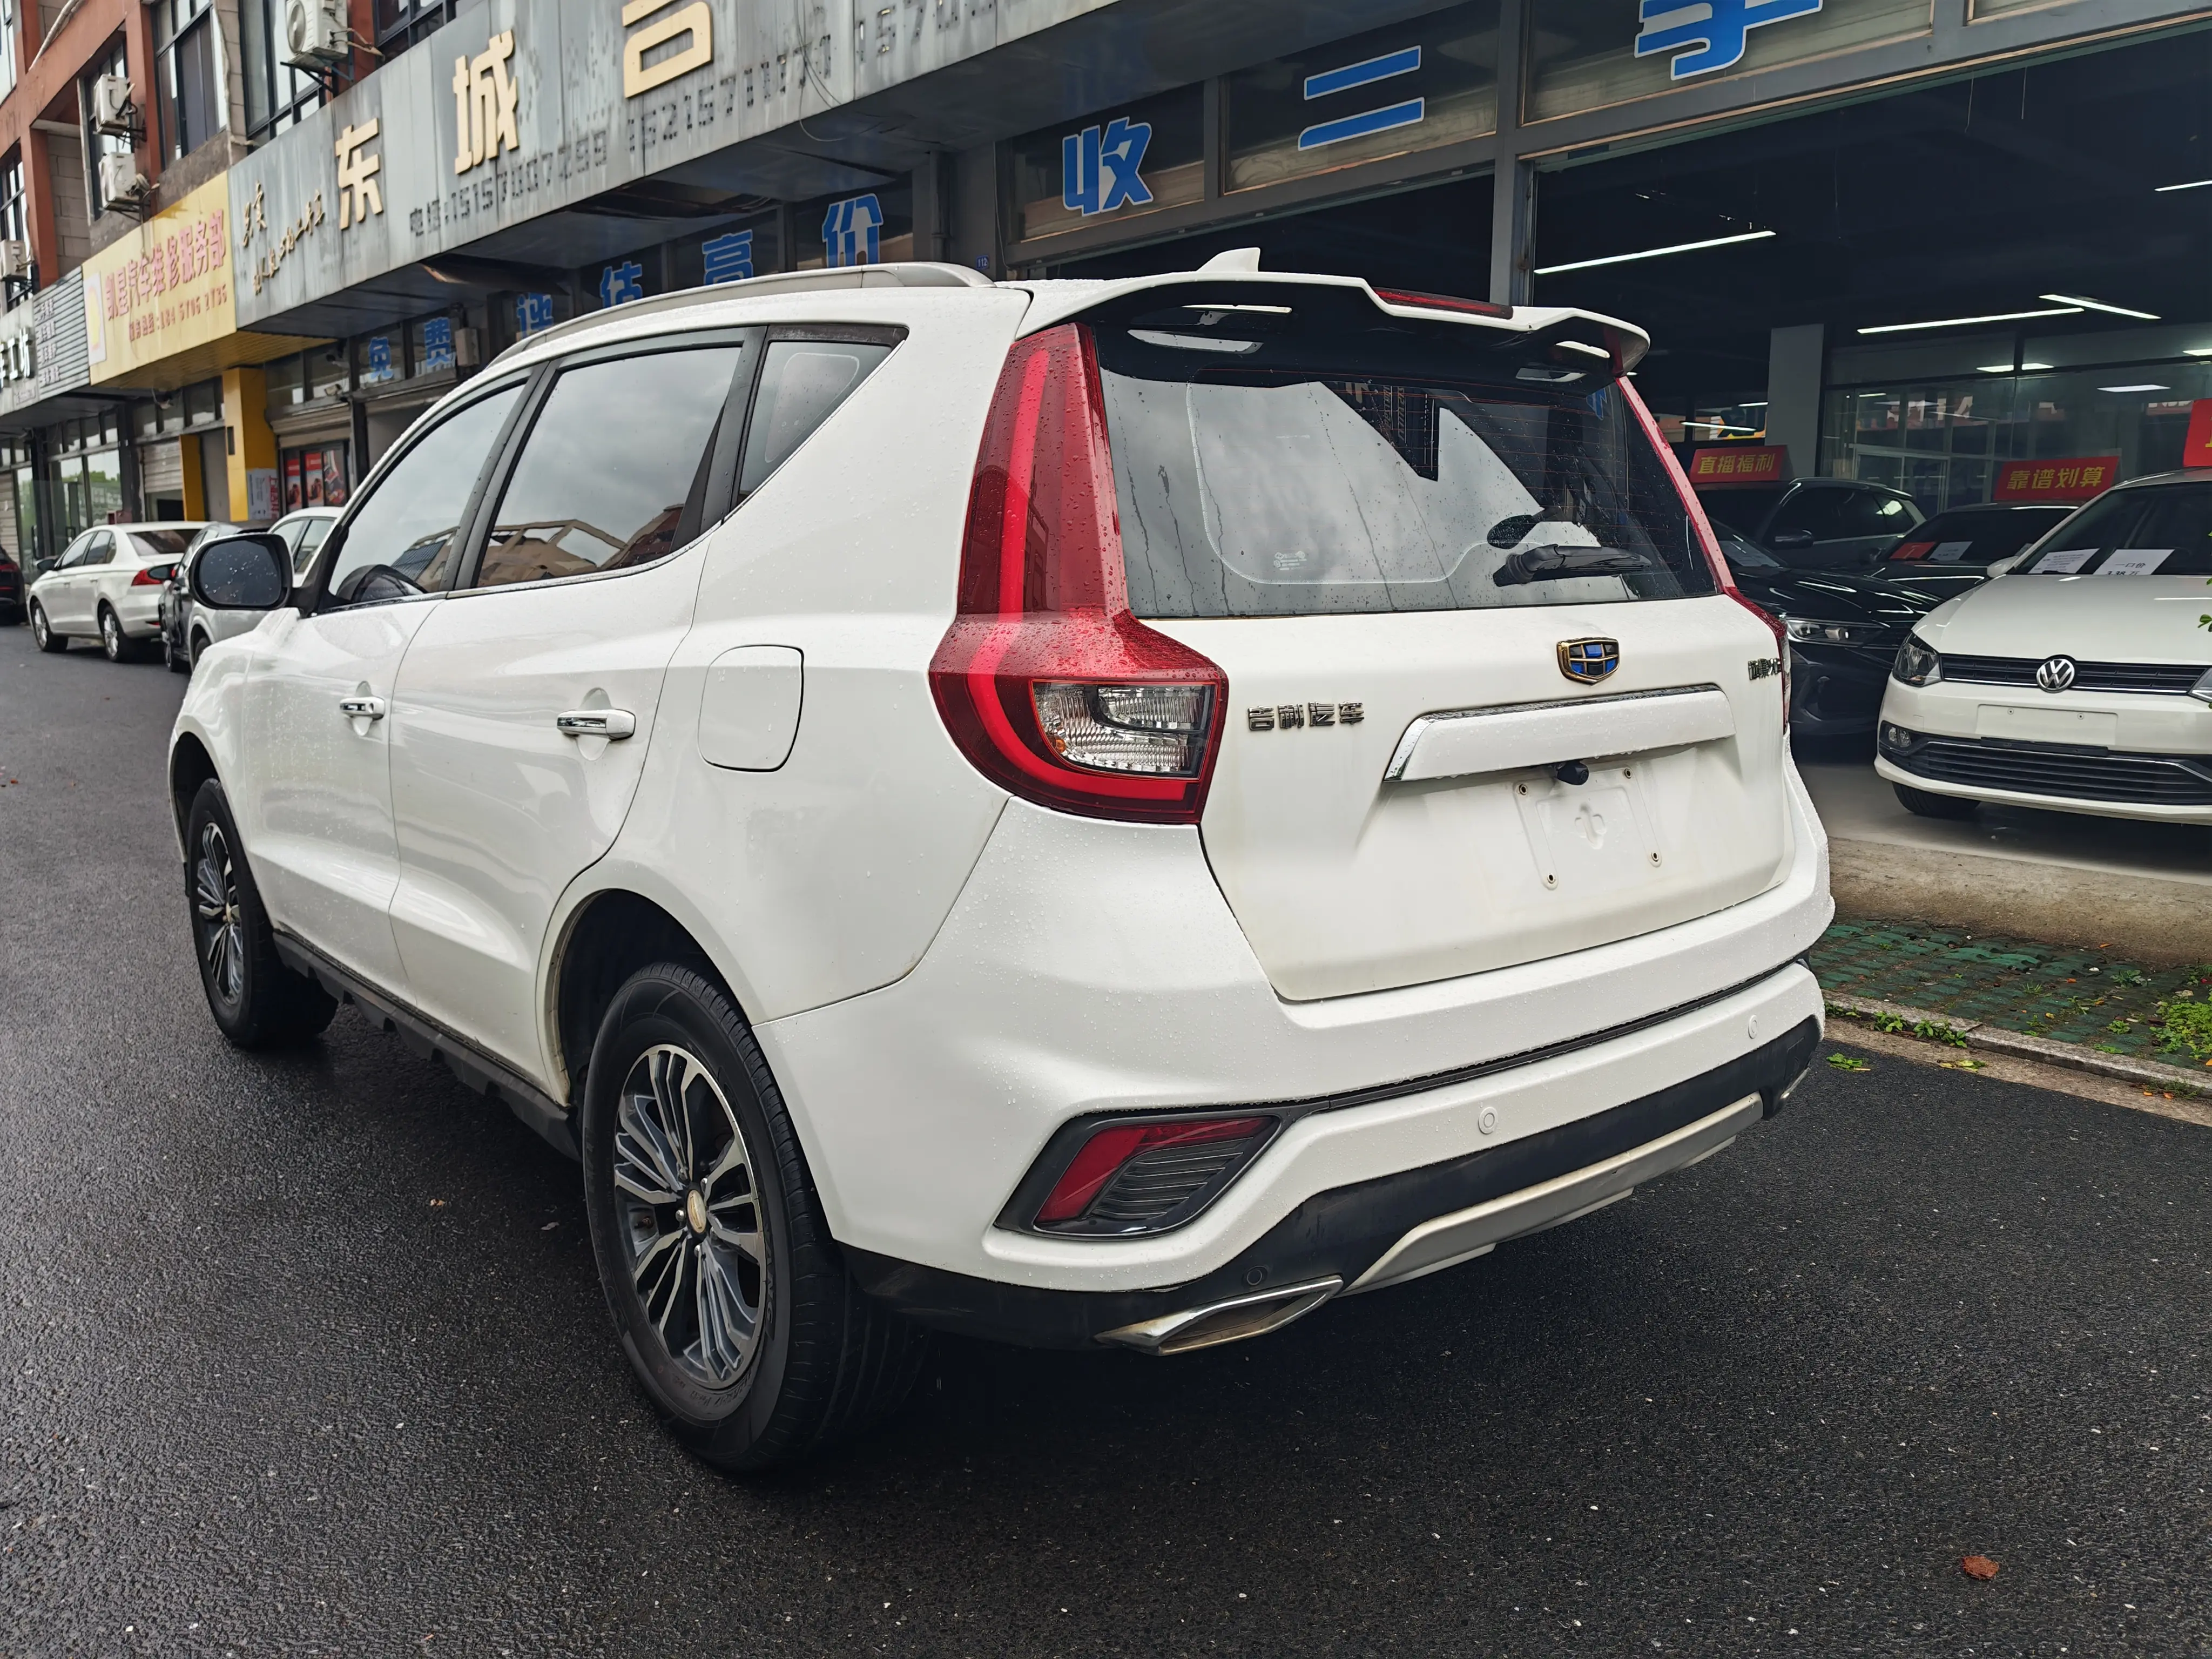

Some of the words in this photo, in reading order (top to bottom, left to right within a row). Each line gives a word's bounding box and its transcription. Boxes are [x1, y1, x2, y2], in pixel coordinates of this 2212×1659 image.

[1697, 453, 1775, 474] 直播福利
[2006, 466, 2106, 490] 靠谱划算
[1247, 700, 1365, 730] 吉利汽车
